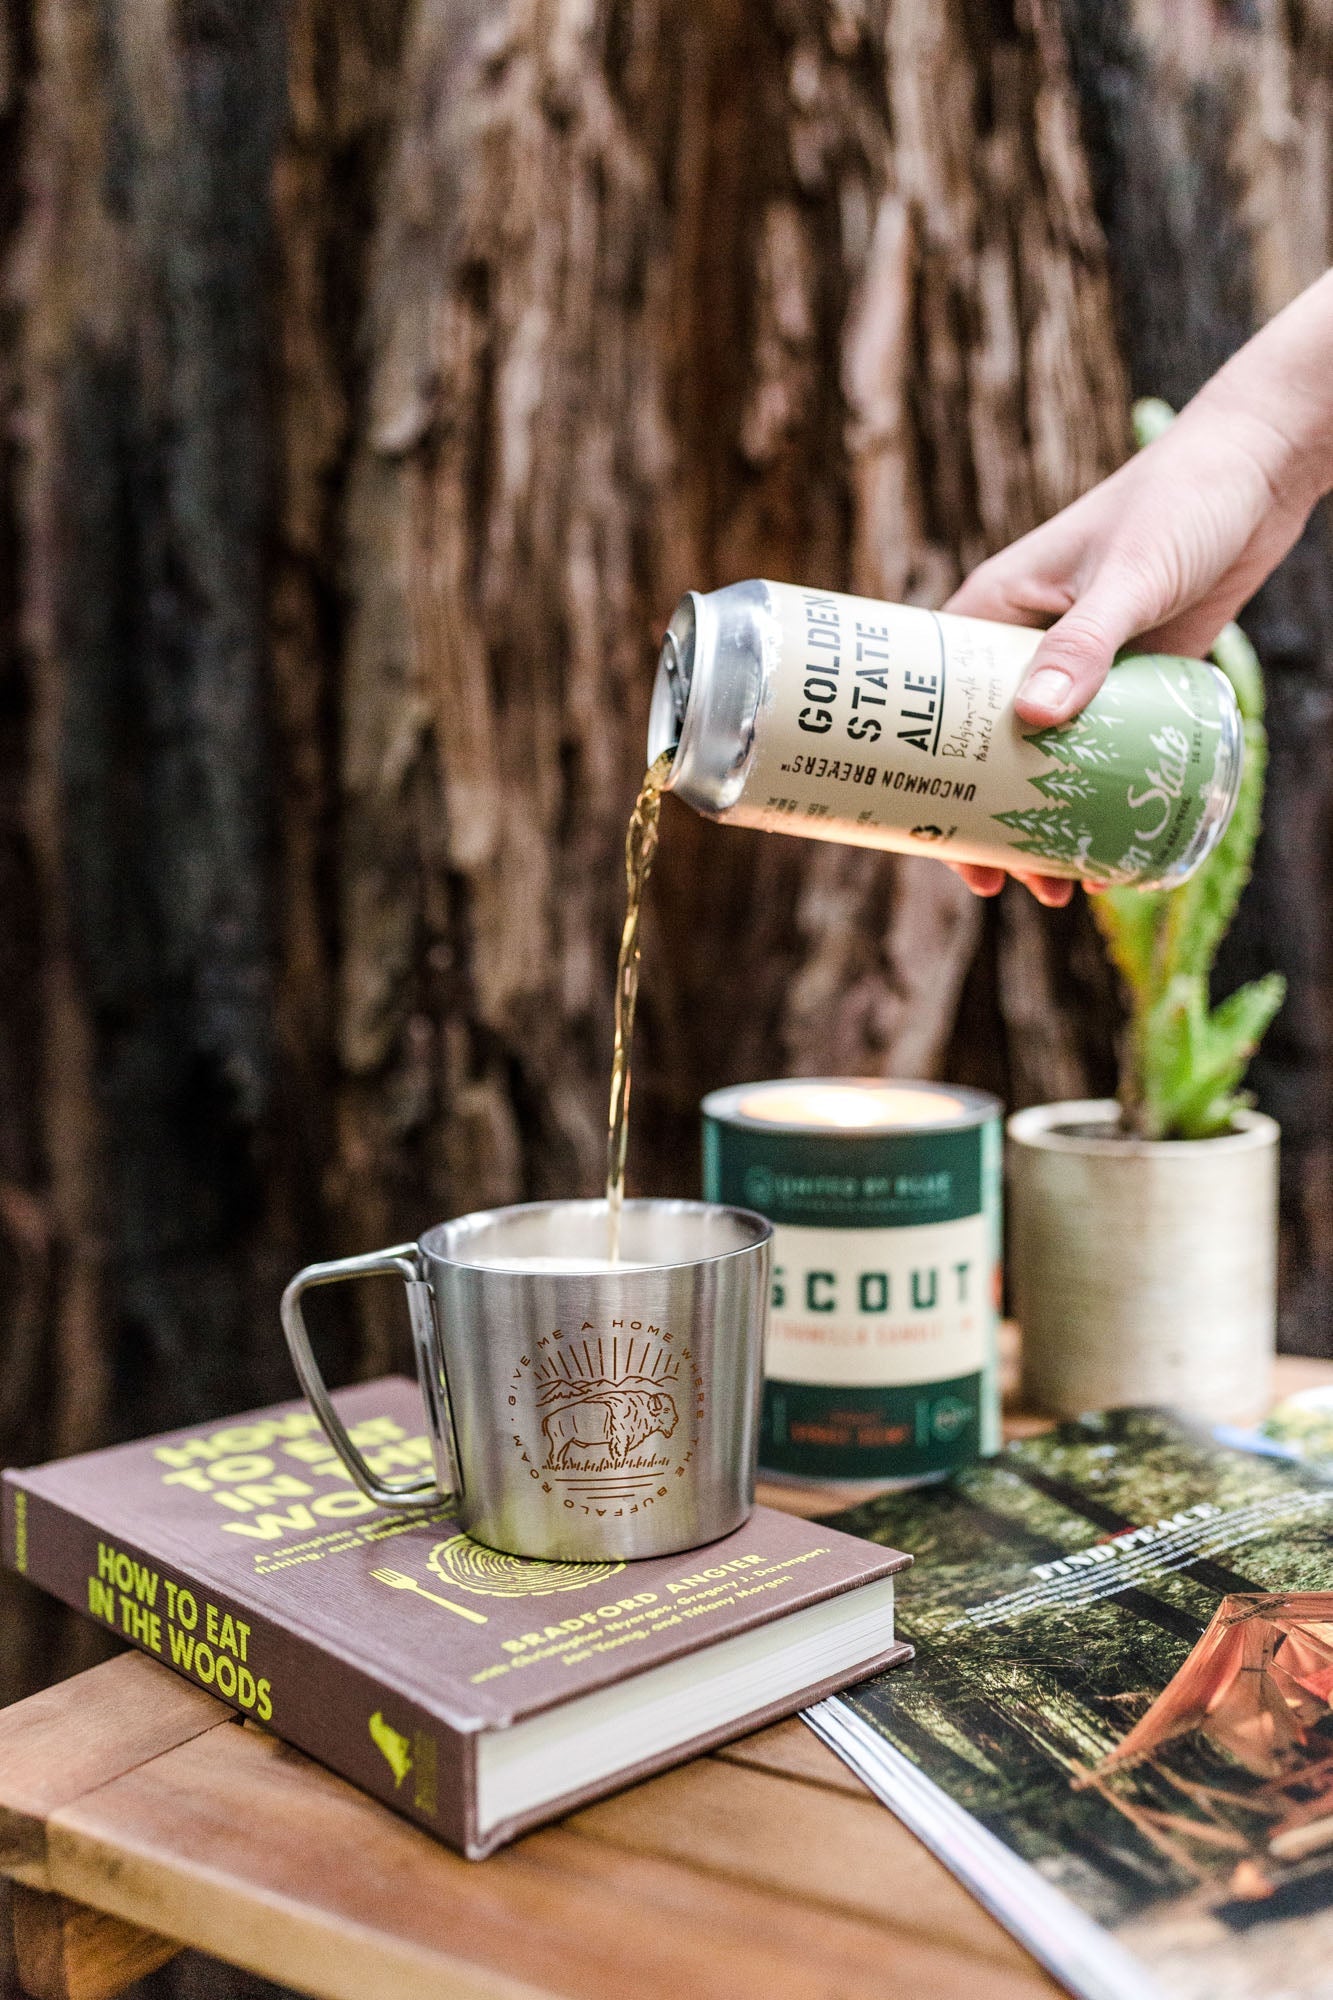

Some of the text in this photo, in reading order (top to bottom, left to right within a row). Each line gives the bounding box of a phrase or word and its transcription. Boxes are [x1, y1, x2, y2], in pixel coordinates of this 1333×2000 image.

[798, 594, 841, 734] GOLDEN
[846, 622, 889, 743] STATE
[897, 670, 937, 751] ALE
[973, 716, 993, 762] toasted
[882, 772, 977, 802] UNCOMMON
[1128, 726, 1189, 841] State
[154, 1413, 322, 1468] HOW
[508, 1319, 705, 1517] GIVE ME A HOME WHERE THE BUFFALO ROAM
[162, 1454, 274, 1492] TO
[212, 1475, 314, 1513] IN
[254, 1519, 430, 1574] fishing, and finding
[254, 1554, 270, 1564] A
[272, 1530, 353, 1557] complete
[1030, 1544, 1117, 1580] FIND
[1111, 1502, 1222, 1551] PEACE
[98, 1541, 251, 1663] HOW TO EAT
[501, 1554, 768, 1653] BRADFORD ANGIER
[651, 1614, 683, 1632] and
[735, 1575, 793, 1598] Morgan
[676, 1580, 739, 1605] Gregory
[752, 1548, 831, 1577] Davenport,
[88, 1576, 273, 1721] IN THE WOODS
